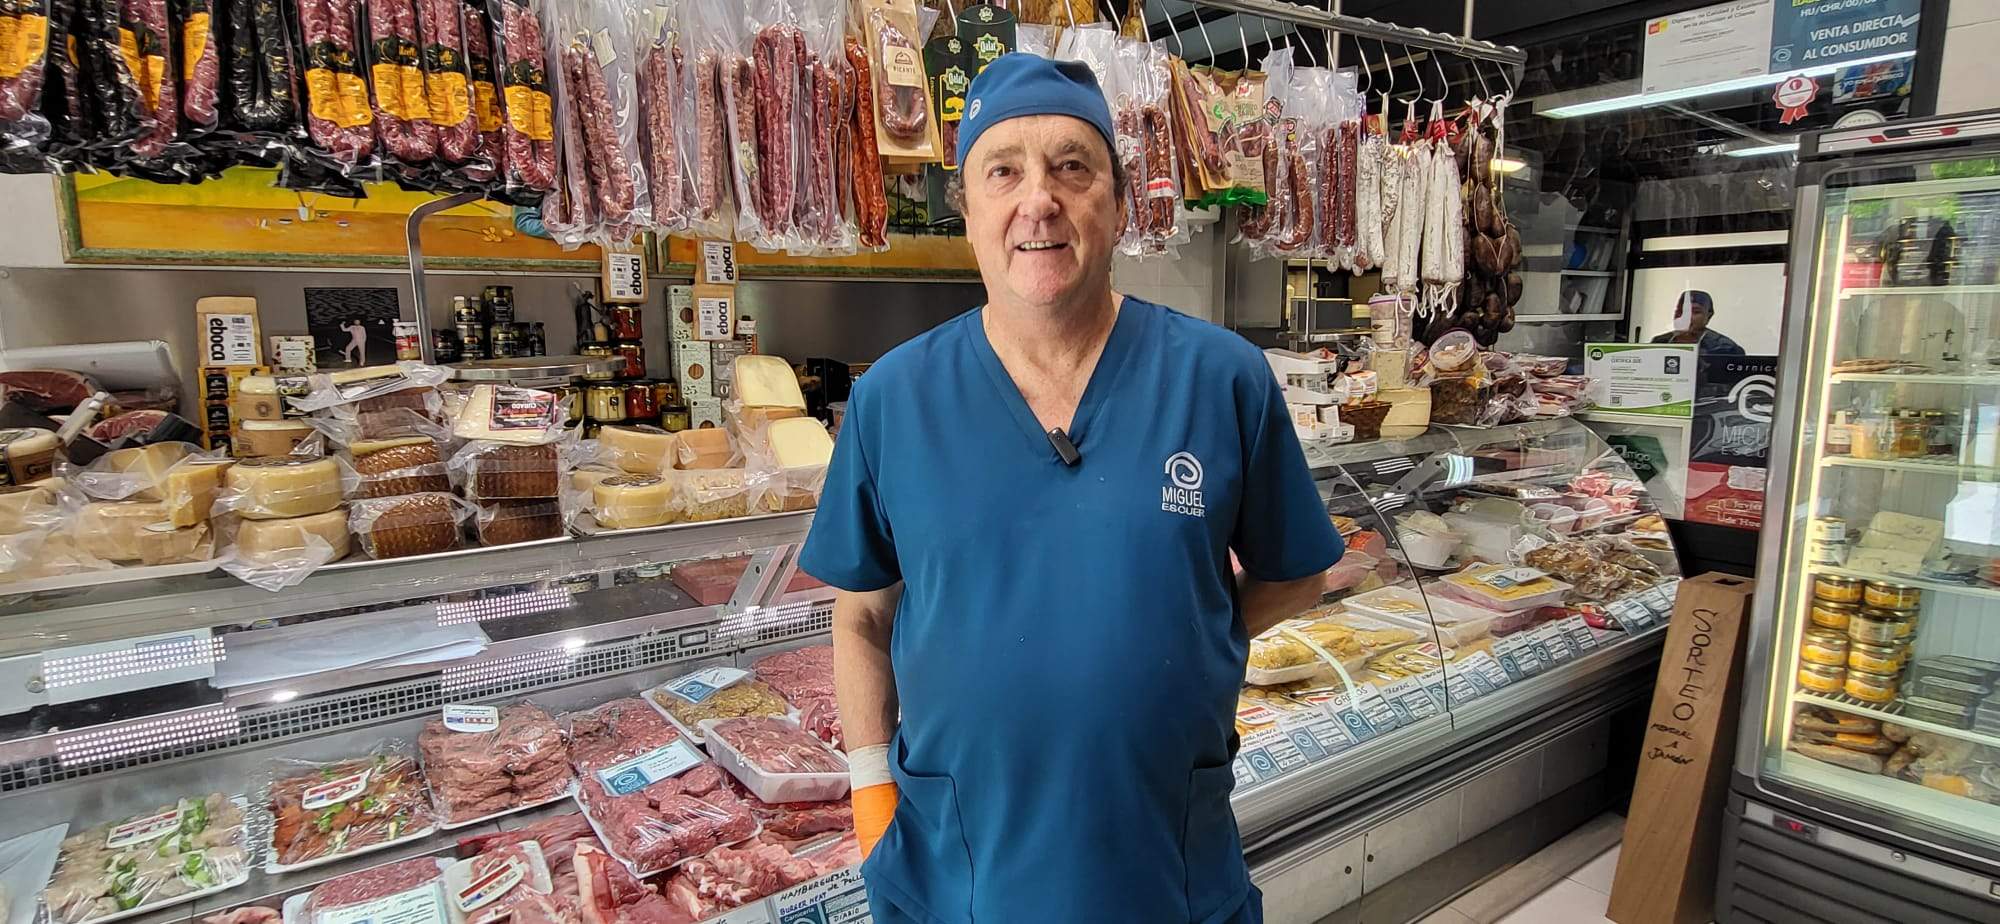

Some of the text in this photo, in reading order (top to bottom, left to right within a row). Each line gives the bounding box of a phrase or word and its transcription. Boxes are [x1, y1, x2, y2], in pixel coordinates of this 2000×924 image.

[1810, 13, 1904, 41] VENTA DIRECTA
[1802, 32, 1908, 61] AL CONSUMIDOR
[629, 257, 643, 296] eboca
[721, 246, 735, 281] eboca
[716, 301, 728, 336] eboca
[209, 317, 228, 361] eboca
[1721, 446, 1766, 458] ESCU
[1162, 486, 1206, 508] MIGUEL
[1672, 608, 1719, 721] SORTEO
[780, 869, 851, 902] HAMBURGUESAS
